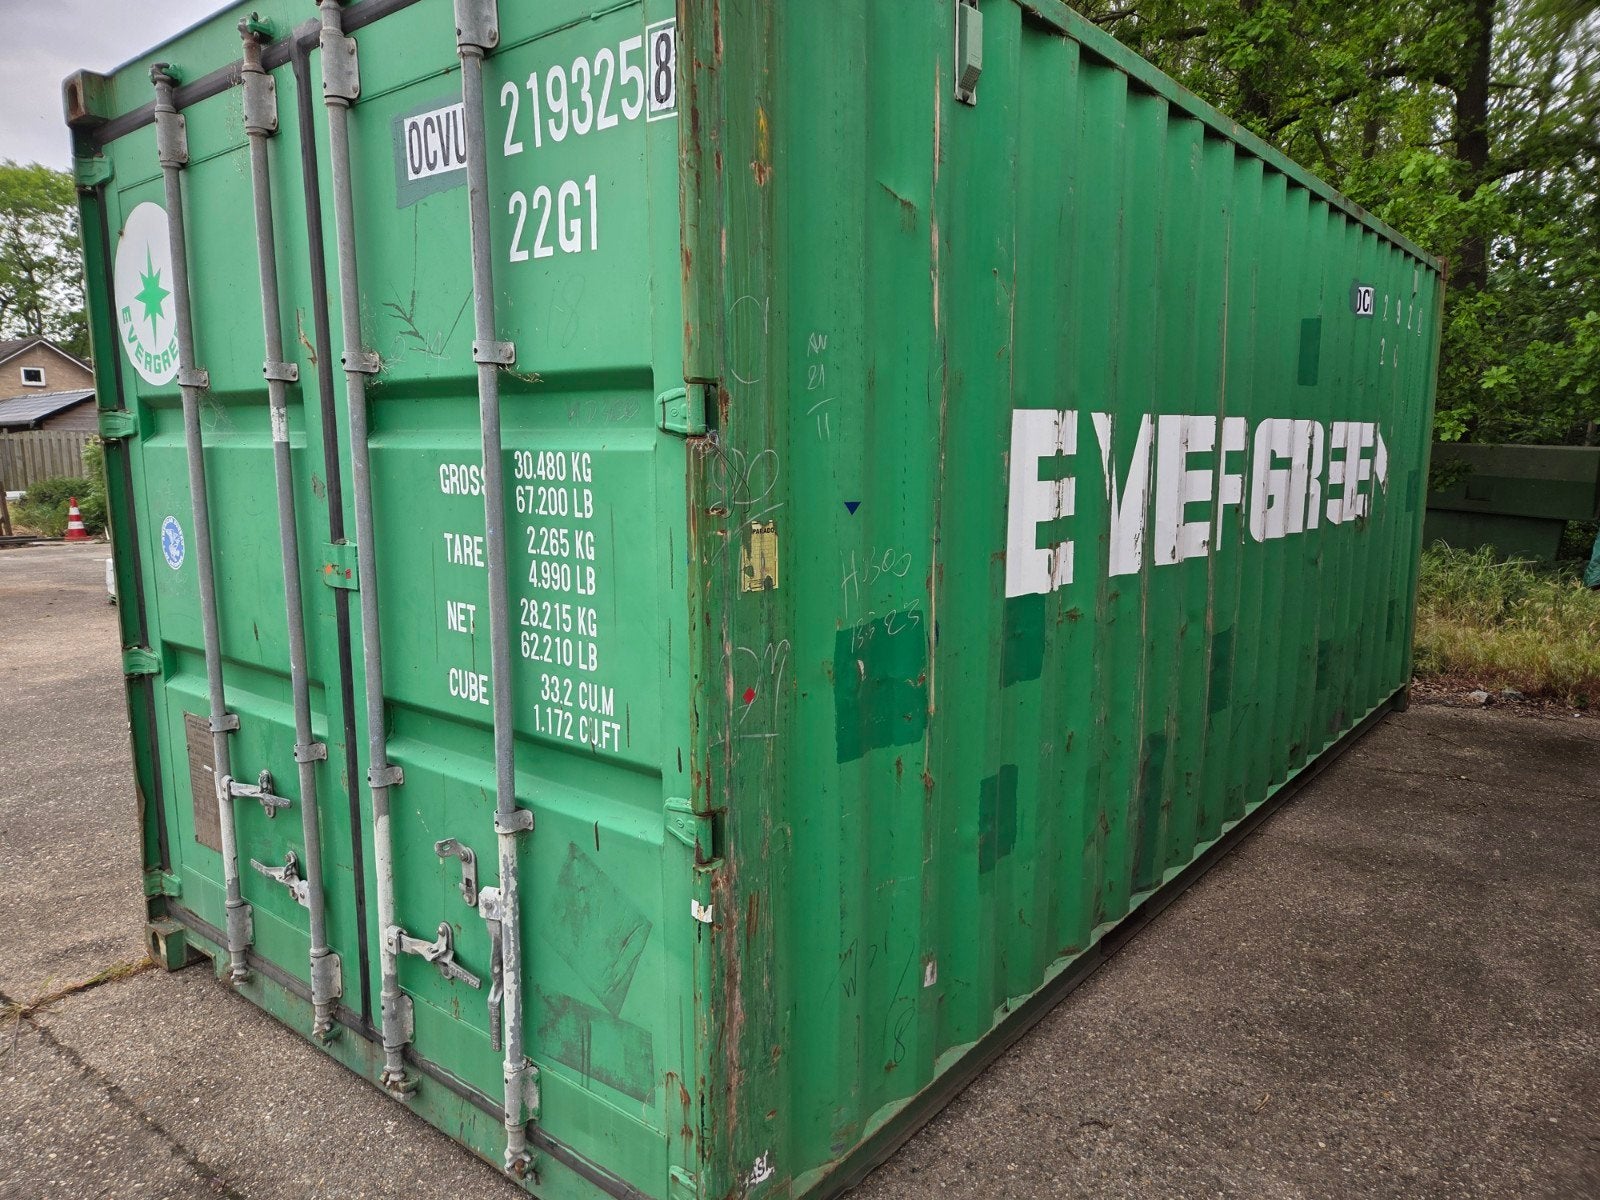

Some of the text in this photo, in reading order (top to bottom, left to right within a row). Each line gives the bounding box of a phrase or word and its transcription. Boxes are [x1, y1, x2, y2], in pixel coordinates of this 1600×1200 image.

[500, 35, 644, 156] 219325
[654, 32, 673, 104] 8
[508, 174, 598, 262] 22G1
[514, 450, 566, 482] 30.480
[571, 452, 592, 483] KG
[516, 485, 593, 519] 67.200 LB
[444, 525, 595, 567] TARE 2.265 KG
[528, 560, 596, 596] 4.990 LB
[446, 598, 597, 637] NET 28.215 KG
[521, 631, 598, 672] 62.210 LB
[449, 667, 614, 717] CUBE 33.2 CU.M
[533, 704, 621, 752] 1.172 CU.FT
